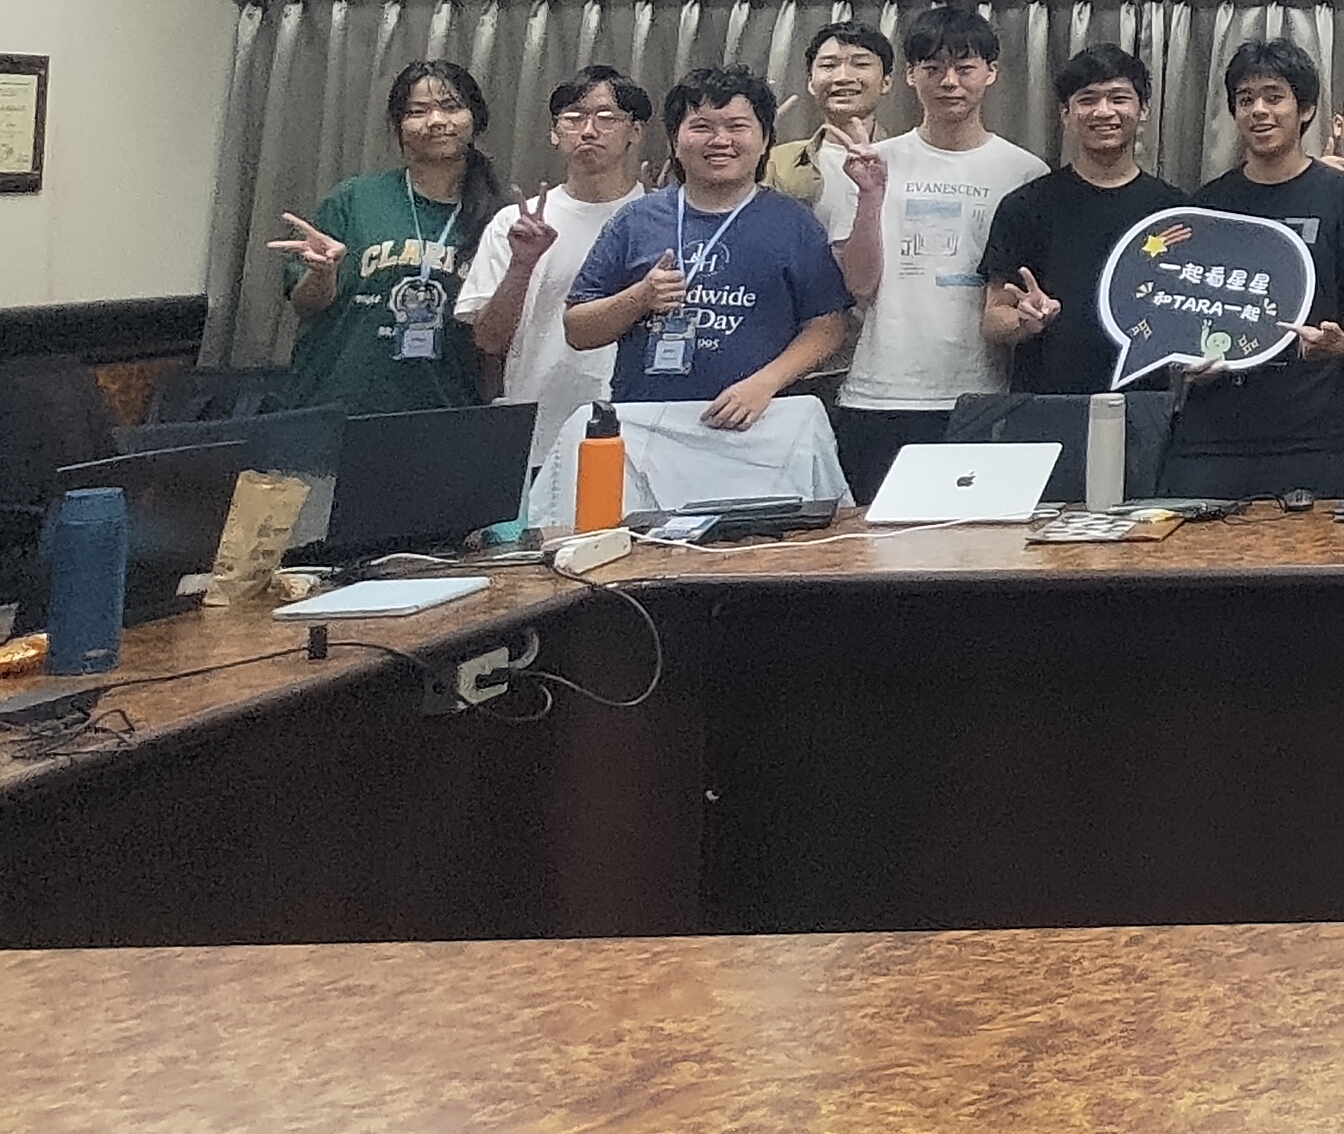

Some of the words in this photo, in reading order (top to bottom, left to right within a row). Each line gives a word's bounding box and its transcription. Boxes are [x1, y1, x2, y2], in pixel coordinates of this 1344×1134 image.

[905, 182, 990, 198] EVANESCENT
[1158, 261, 1271, 295] 一起看星星
[685, 284, 757, 307] dwide
[1152, 290, 1262, 323] 和TARA一起
[695, 308, 745, 335] Day
